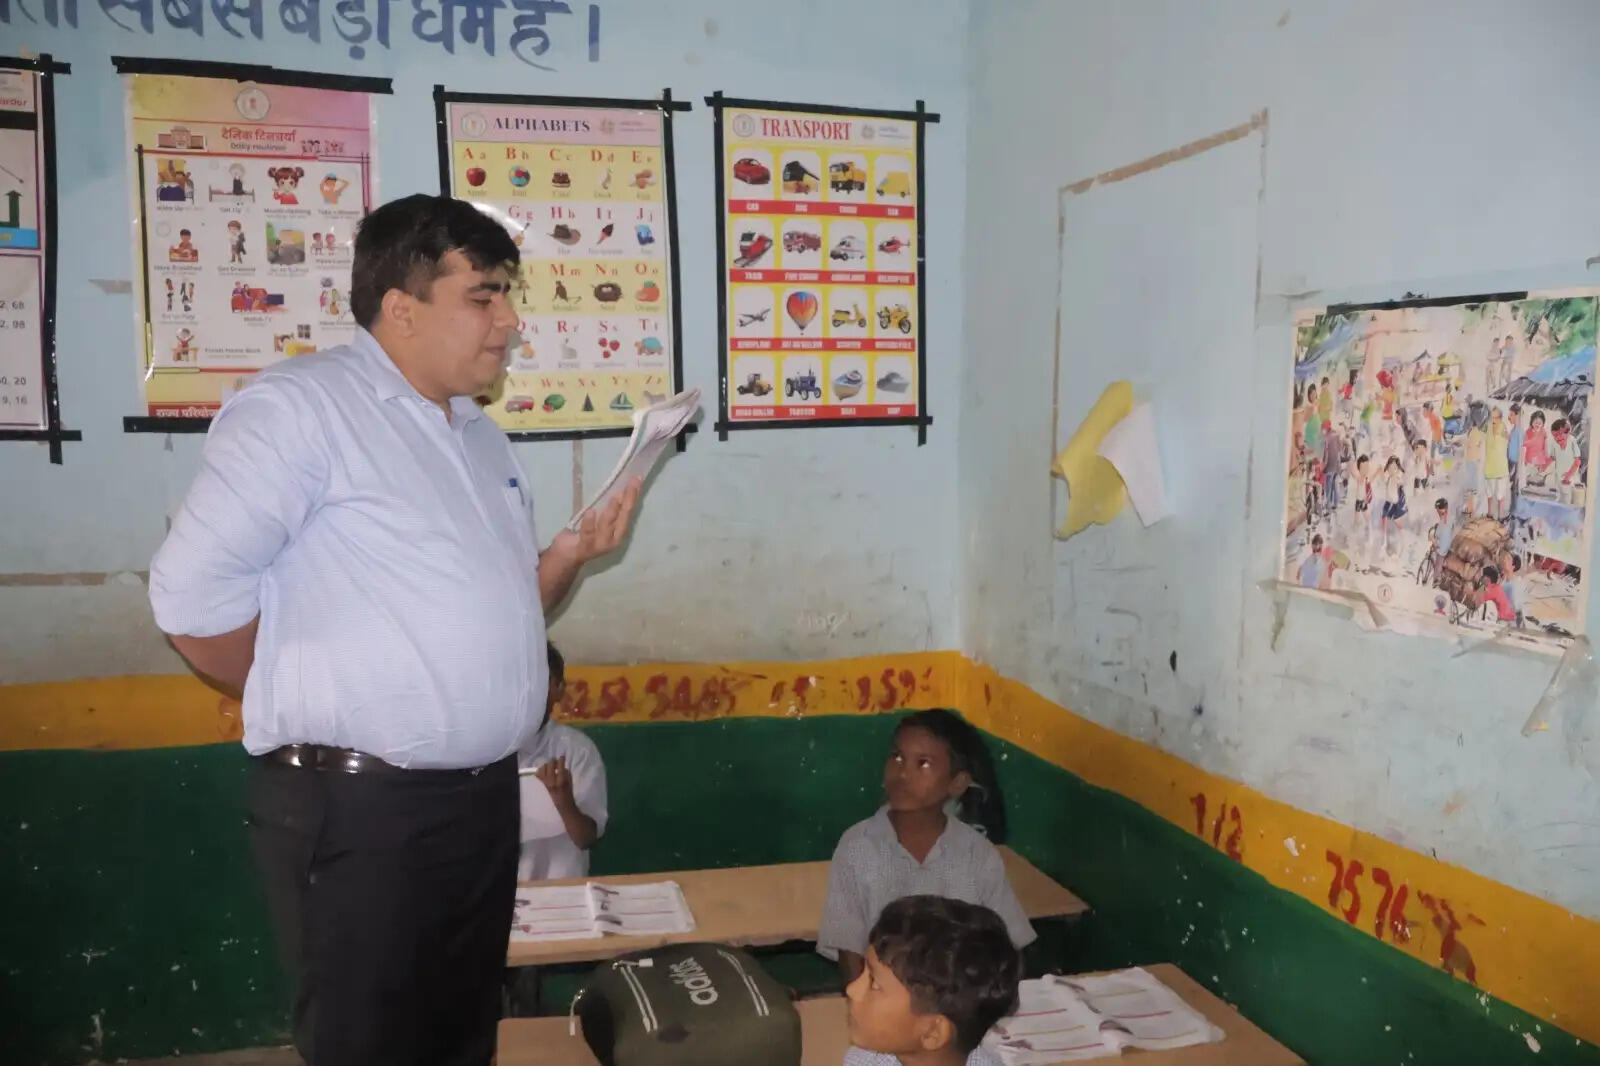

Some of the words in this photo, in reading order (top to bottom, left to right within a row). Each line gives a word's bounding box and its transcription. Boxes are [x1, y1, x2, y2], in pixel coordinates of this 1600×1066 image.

[493, 117, 591, 132] ALPHABETS
[761, 118, 852, 140] TRANSPORT
[464, 147, 474, 160] A
[505, 147, 516, 160] B
[550, 148, 561, 161] C
[590, 150, 602, 162] D
[632, 151, 642, 163] E
[508, 205, 520, 219] G
[551, 206, 563, 219] H
[550, 263, 565, 276] M
[595, 263, 606, 275] N
[557, 320, 568, 333] R
